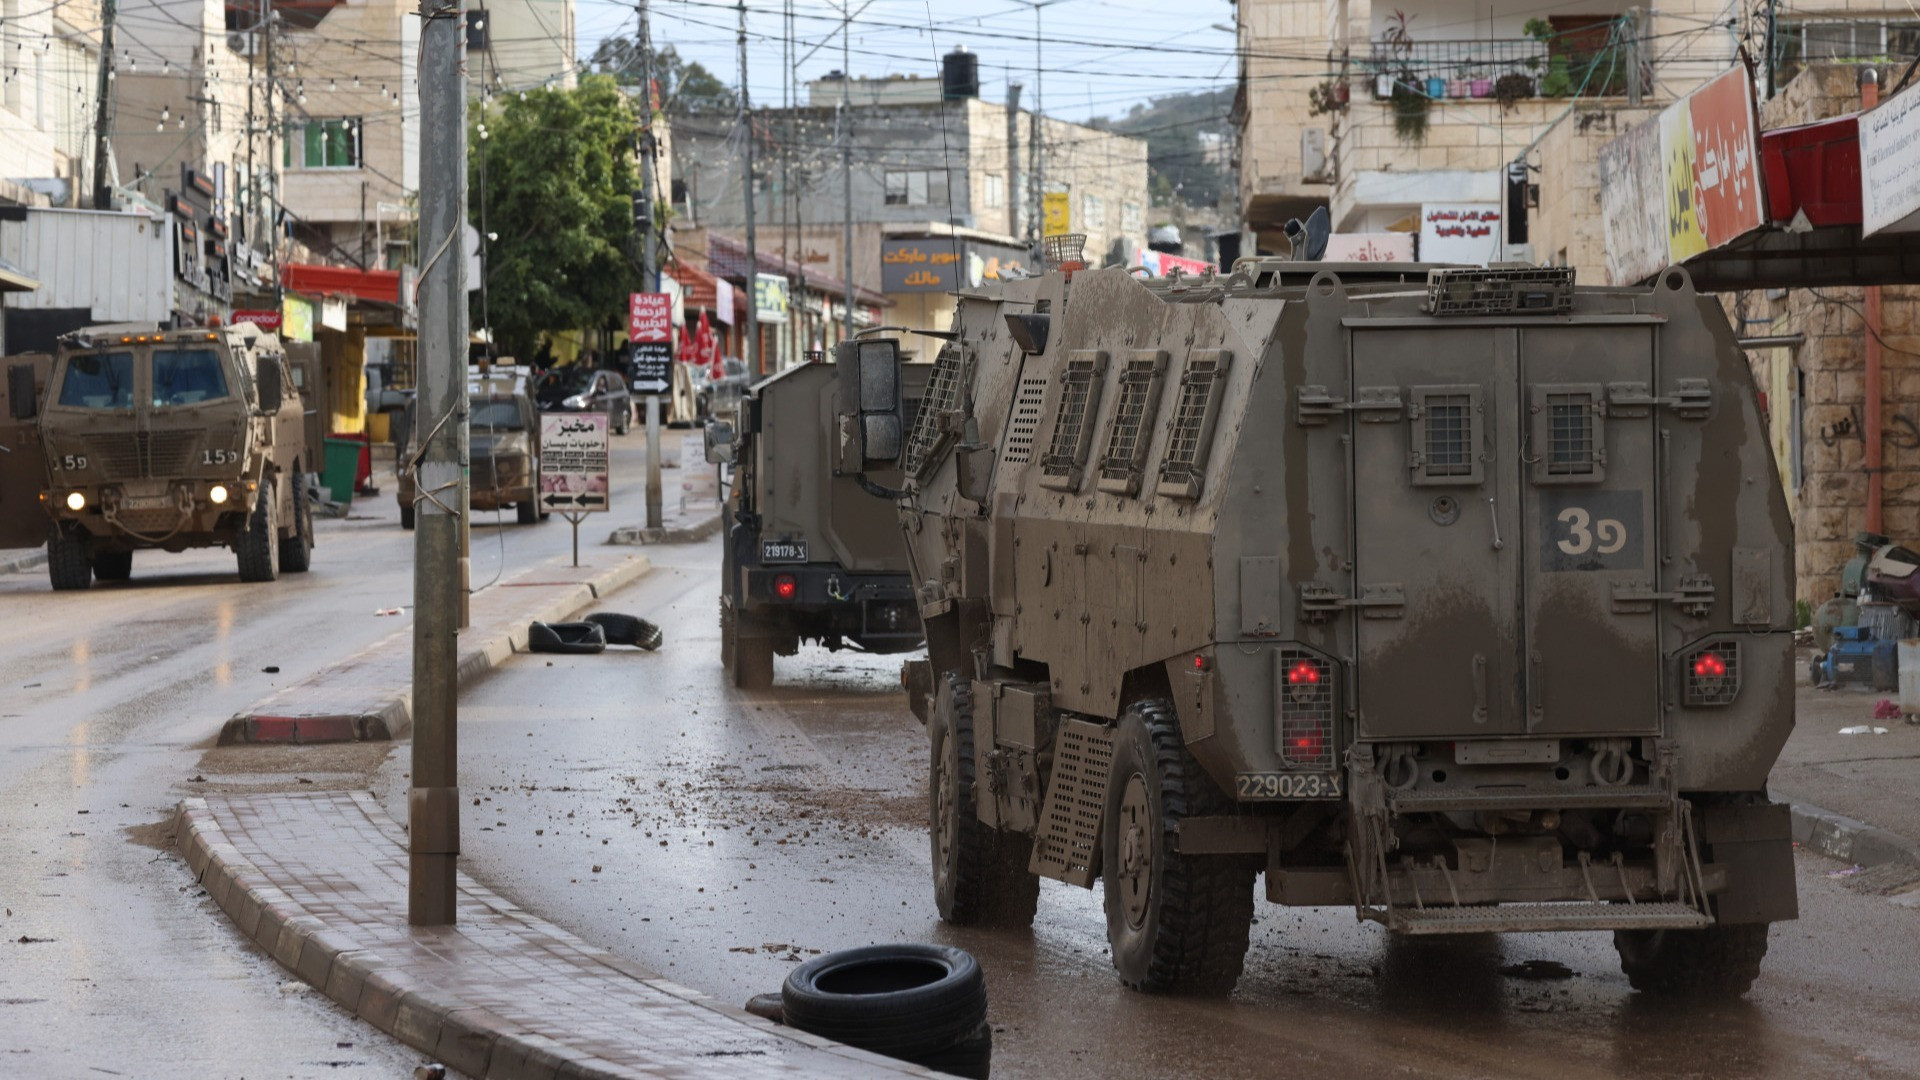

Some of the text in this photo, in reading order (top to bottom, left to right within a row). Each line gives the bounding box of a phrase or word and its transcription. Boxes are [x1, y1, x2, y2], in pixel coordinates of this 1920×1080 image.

[1696, 122, 1731, 198] ماركت
[883, 248, 927, 265] ماركت
[904, 270, 941, 286] مالك
[634, 294, 665, 306] عيادة
[633, 306, 667, 318] الرحمة
[632, 318, 668, 330] الطبية
[557, 418, 594, 437] مخبز
[542, 440, 568, 449] بيسان
